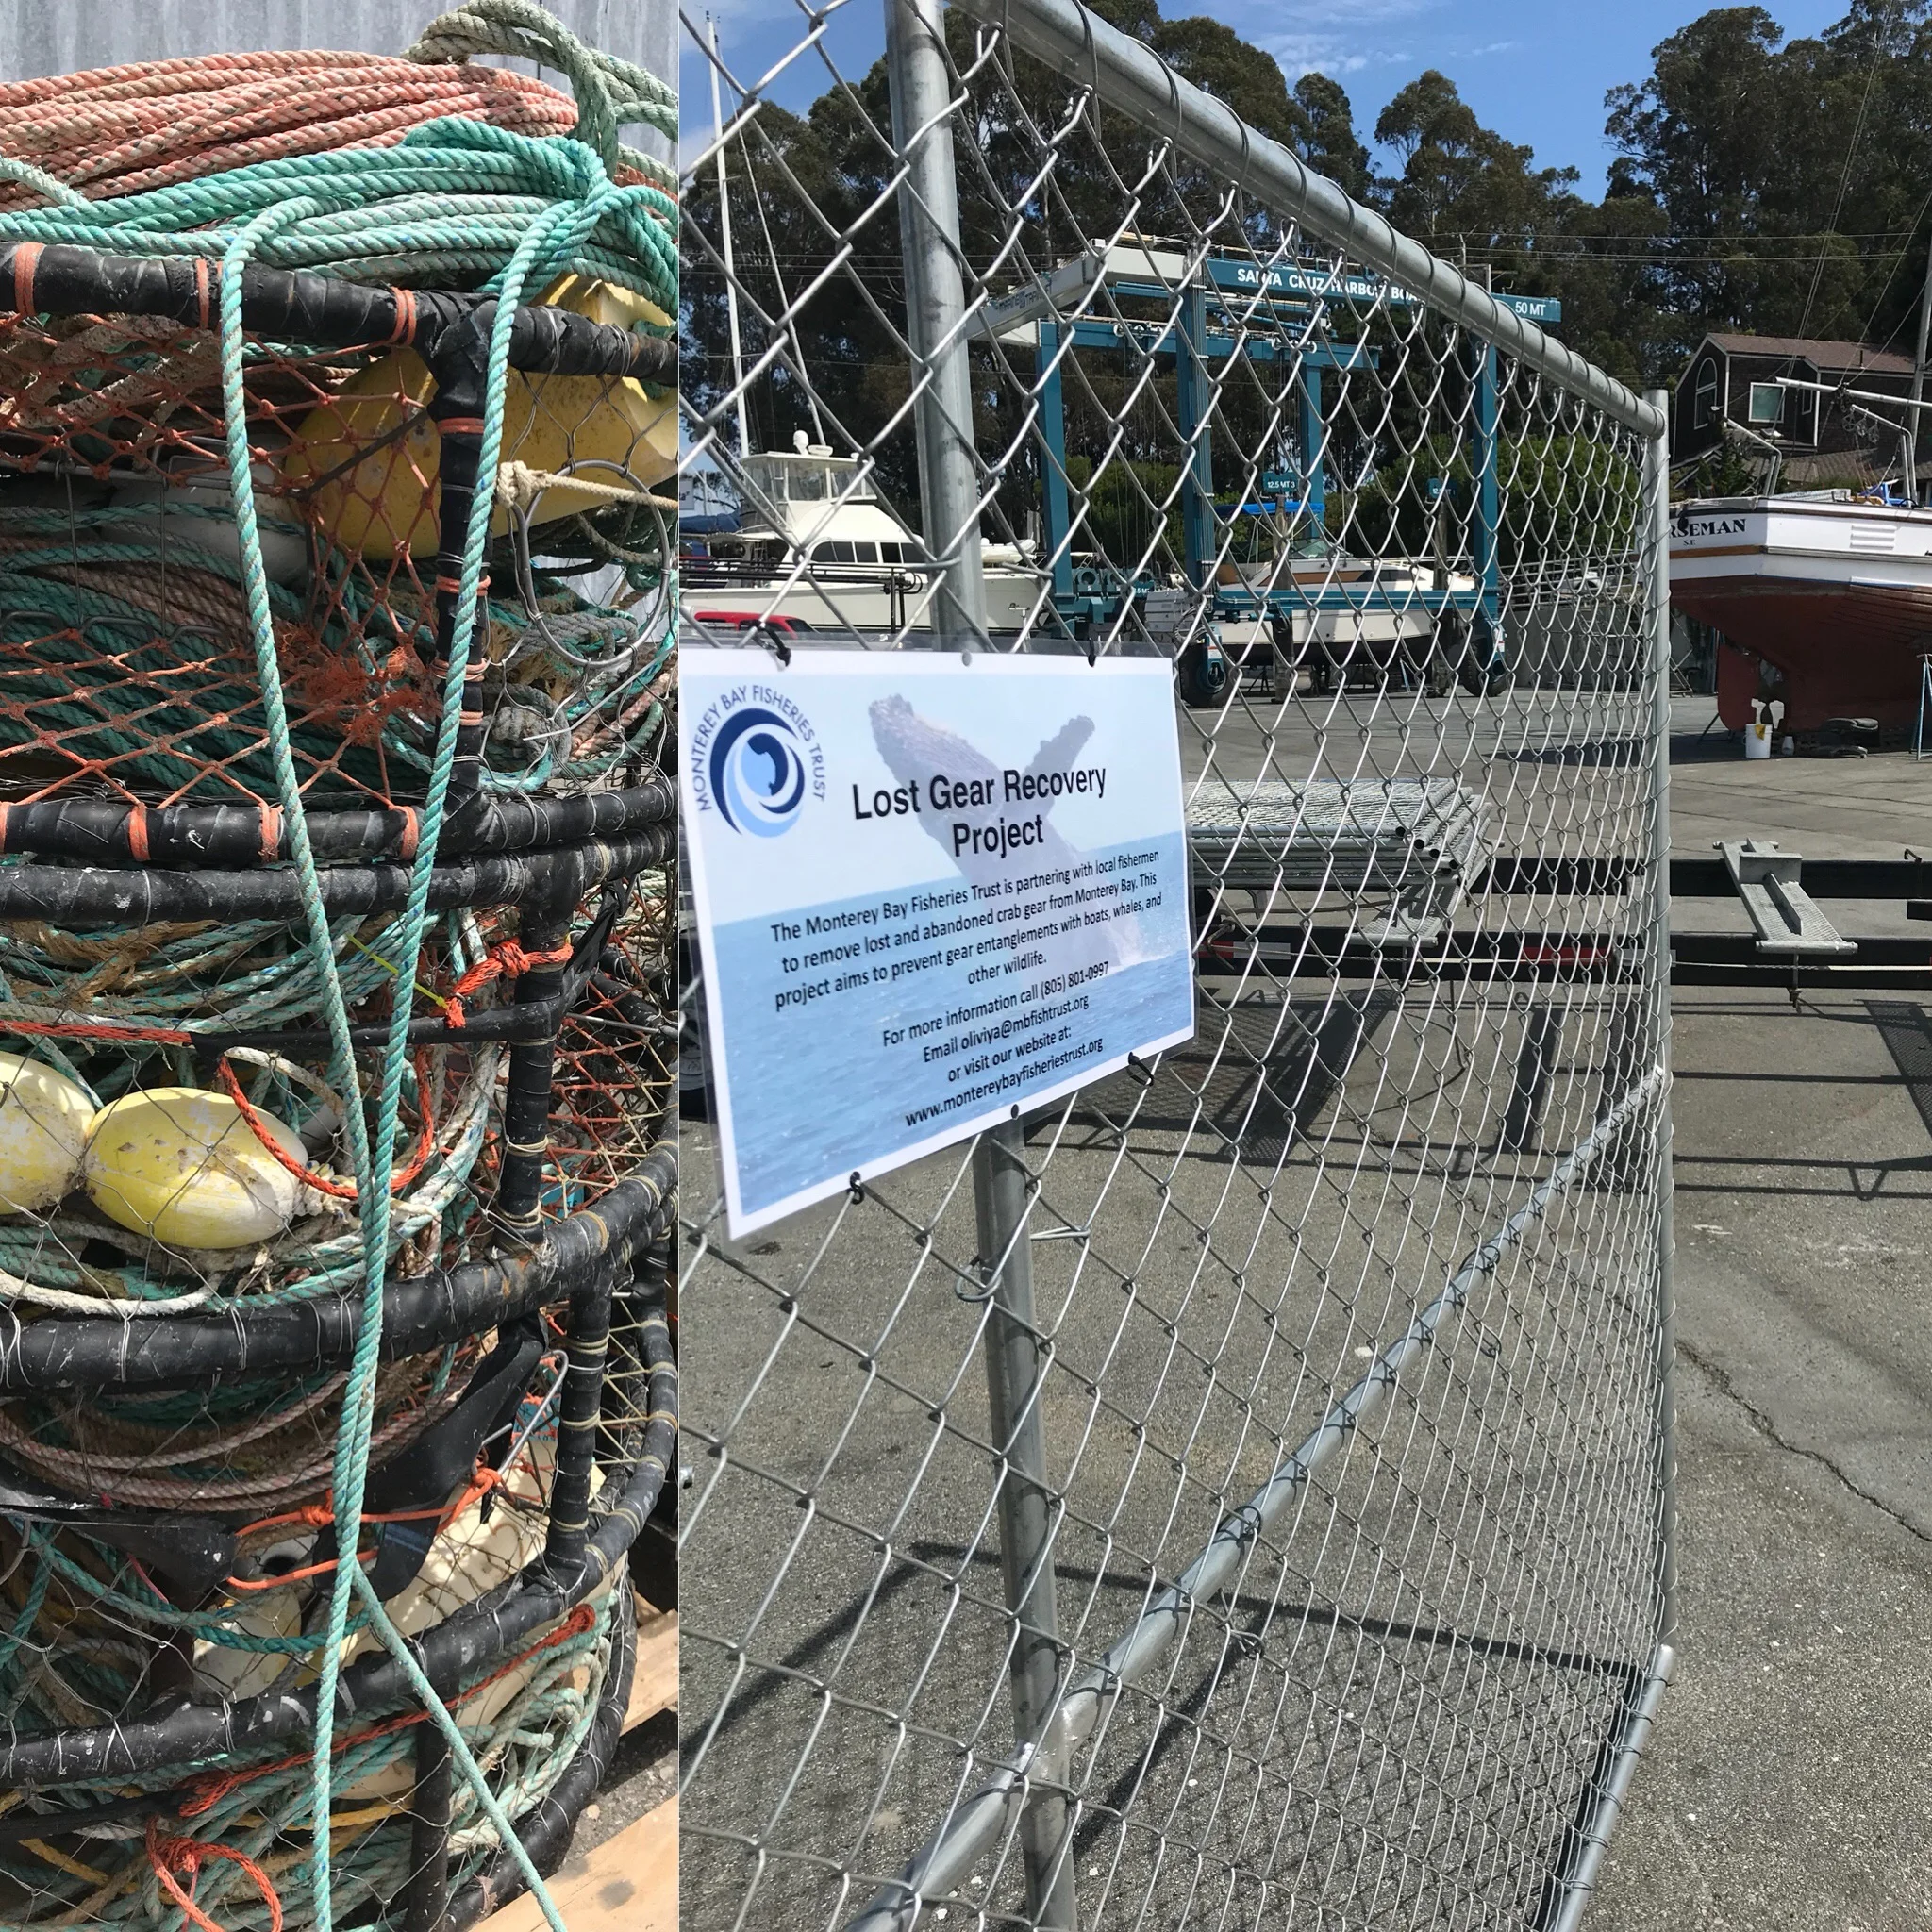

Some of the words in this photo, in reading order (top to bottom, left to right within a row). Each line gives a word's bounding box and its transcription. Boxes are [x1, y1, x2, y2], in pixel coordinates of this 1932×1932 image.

[1237, 268, 1282, 286] SANTA
[1289, 274, 1324, 290] CRUZ
[1515, 301, 1527, 314] 50
[1529, 303, 1546, 316] MT
[691, 702, 722, 812] MONTEREY
[720, 685, 747, 710] BAY
[752, 685, 816, 741] FISHERIES
[808, 742, 826, 802] TRUST
[853, 783, 921, 820] Lost
[929, 774, 995, 810] Gear
[1003, 768, 1107, 802] Recovery
[953, 814, 1043, 858] Project
[771, 922, 801, 942] The
[806, 908, 879, 936] Monterey
[882, 902, 908, 920] Bay
[911, 889, 969, 913] Fisheries
[971, 882, 1002, 900] Trust
[1004, 878, 1013, 894] is
[1016, 869, 1071, 895] partnering
[1073, 861, 1093, 879] with
[1095, 856, 1116, 874] local
[1118, 850, 1159, 870] fishermen
[781, 957, 799, 974] to
[804, 942, 861, 968] remove
[864, 934, 891, 954] lost
[894, 924, 920, 946] and
[924, 908, 994, 940] abandoned
[997, 903, 1022, 923] crab
[1024, 900, 1047, 920] gear
[1049, 894, 1074, 910] from
[1075, 883, 1120, 904] Monterey
[1121, 878, 1138, 893] Bay.
[1140, 872, 1157, 887] This
[775, 982, 830, 1012] project
[835, 973, 870, 992] aims
[873, 966, 888, 982] to
[891, 950, 943, 981] prevent
[946, 944, 974, 967] gear
[976, 923, 1058, 955] entanglements
[1060, 914, 1082, 933] with
[1084, 908, 1111, 926] boats,
[1113, 899, 1144, 918] whales,
[1145, 892, 1162, 908] and
[968, 965, 1001, 985] other
[1003, 950, 1047, 974] wildlife.
[883, 1029, 905, 1047] For
[908, 1017, 943, 1040] more
[946, 994, 1018, 1027] information
[1020, 984, 1039, 1003] call
[1041, 974, 1066, 1000] (805)
[1068, 960, 1109, 988] 801-0997
[924, 1036, 958, 1063] Email
[960, 995, 1089, 1050] oliviya@mbfishtrust.org
[906, 1038, 1104, 1127] www.montereybayfisheriestrust.org
[948, 1066, 961, 1082] or
[964, 1055, 990, 1075] visit
[992, 1048, 1012, 1066] our
[1015, 1033, 1057, 1058] website
[1058, 1025, 1072, 1041] at:
